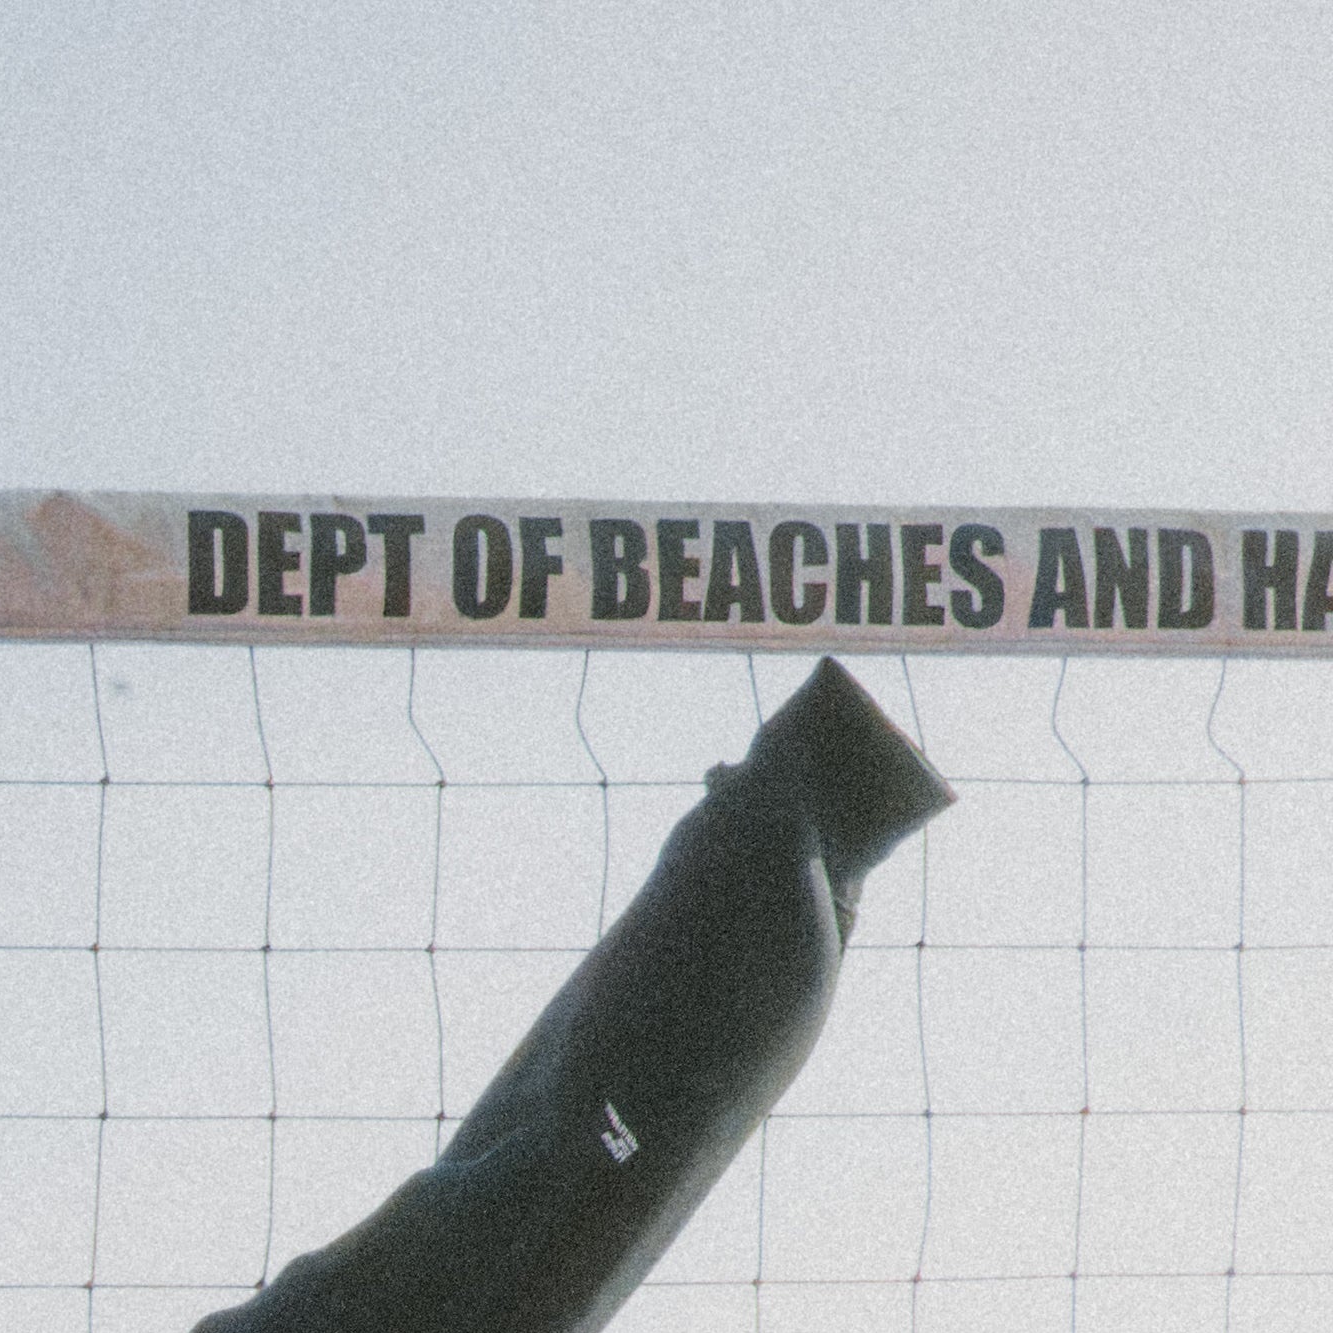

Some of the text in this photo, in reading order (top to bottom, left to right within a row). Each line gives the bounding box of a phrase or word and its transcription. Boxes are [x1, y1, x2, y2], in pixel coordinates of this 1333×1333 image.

[187, 510, 424, 617] DEPT
[452, 515, 564, 620] OF
[589, 518, 1005, 629] BEACHES
[1028, 527, 1215, 630] AND
